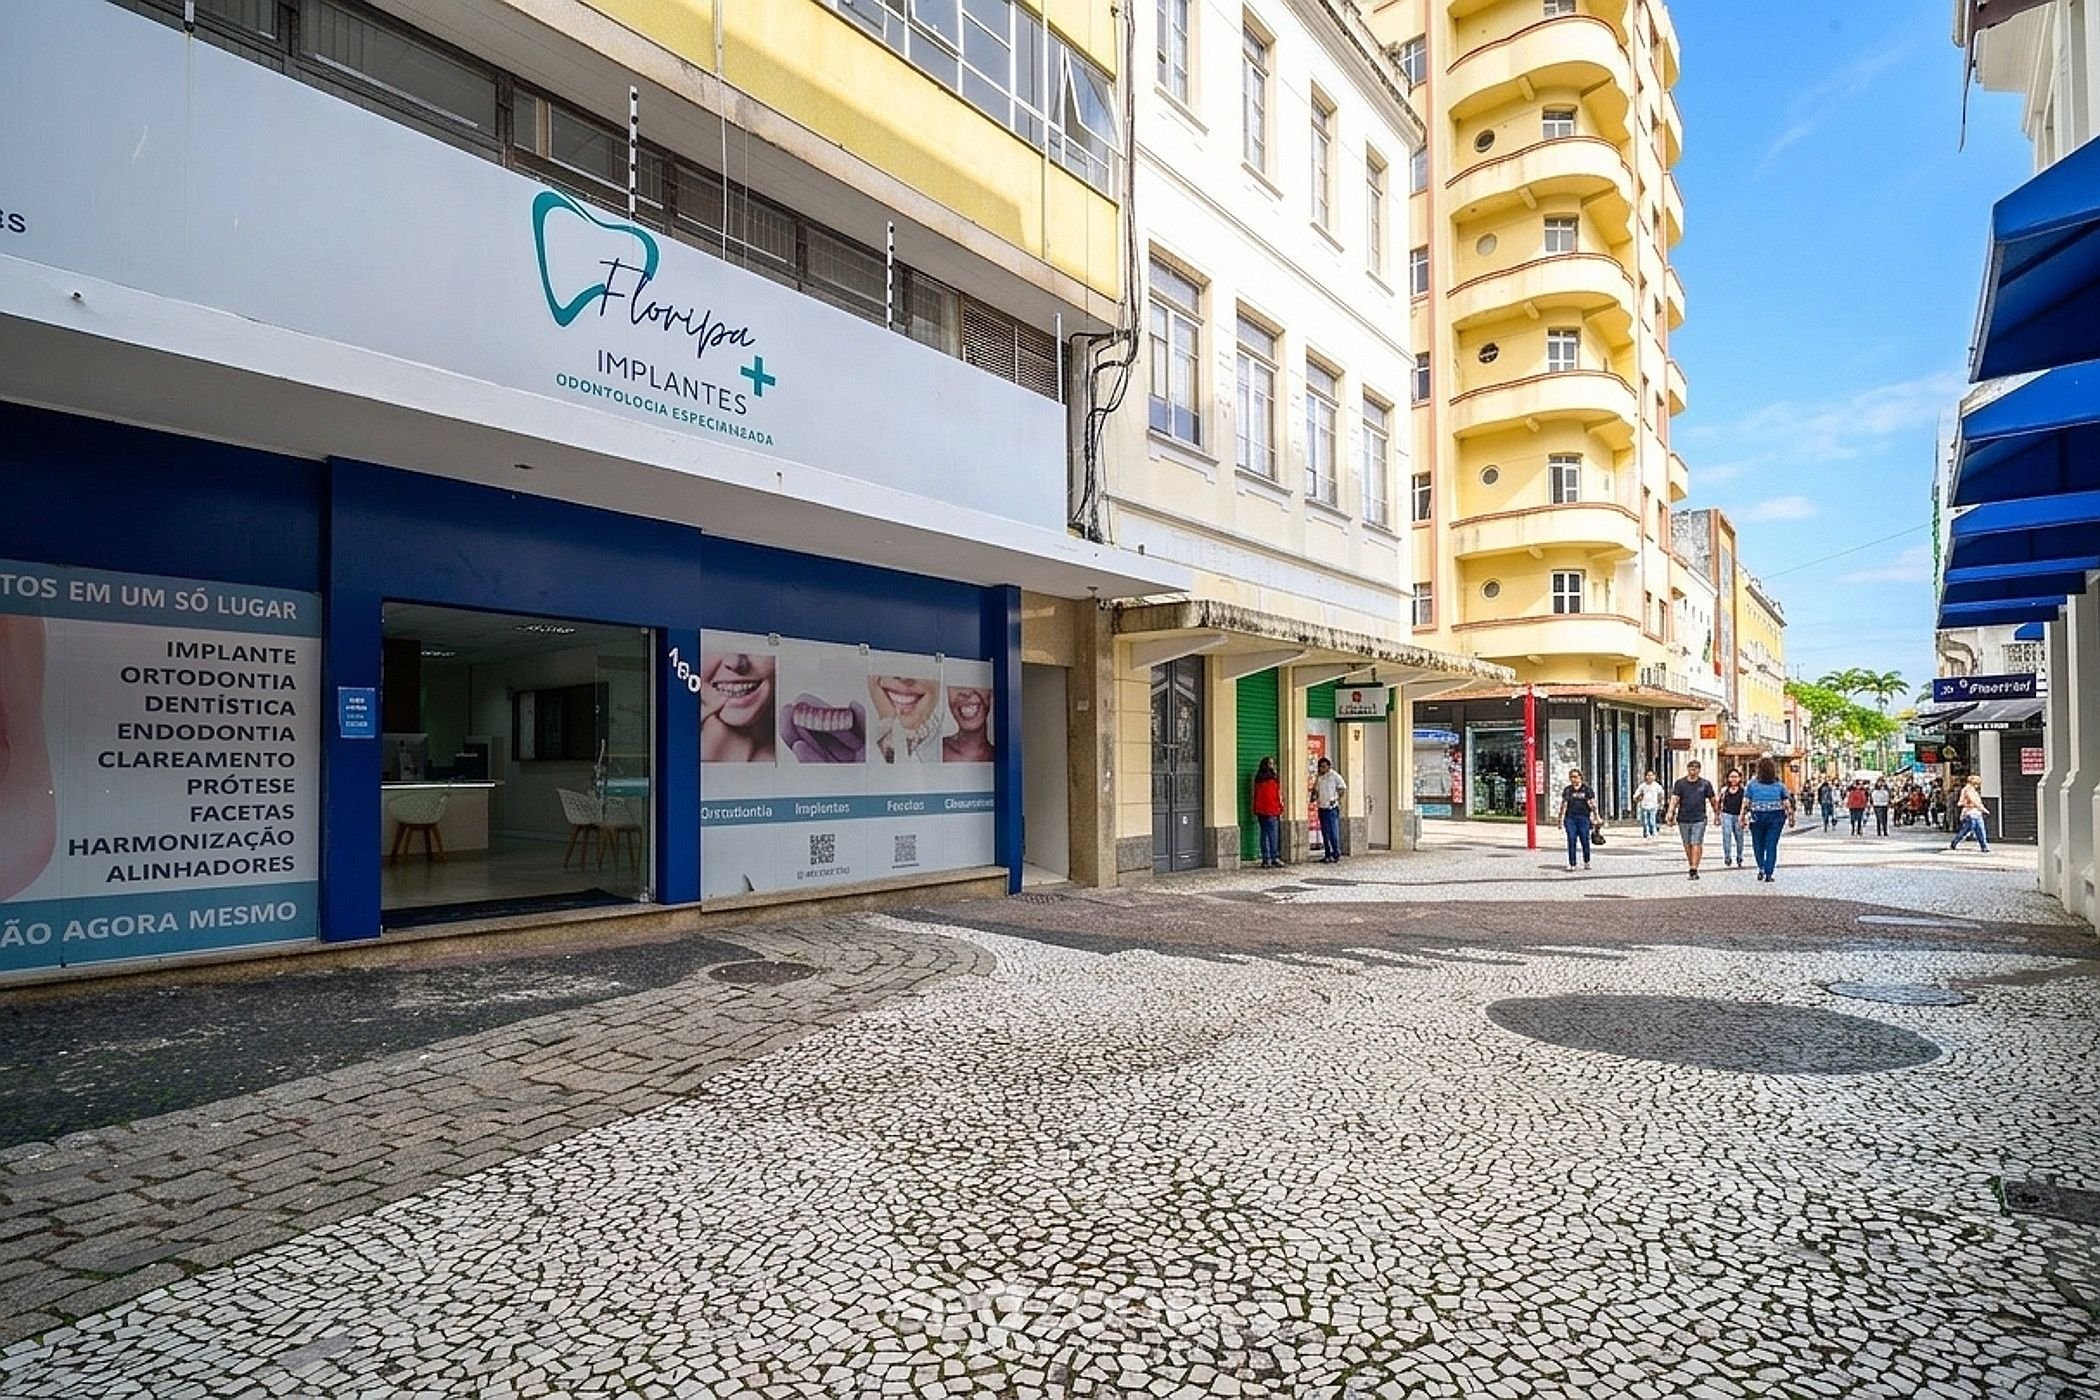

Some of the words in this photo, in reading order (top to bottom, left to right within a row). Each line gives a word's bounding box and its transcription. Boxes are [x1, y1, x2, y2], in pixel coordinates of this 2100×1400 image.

[600, 257, 756, 359] Floripa
[556, 373, 668, 416] ODONTOLOGIA
[597, 349, 748, 416] IMPLANTES
[69, 581, 111, 604] EM
[121, 586, 165, 608] UM
[175, 588, 209, 613] SÓ
[217, 595, 297, 619] LUGAR
[166, 641, 297, 665] IMPLANTE
[120, 667, 297, 690] ORTODONTIA
[145, 694, 297, 716] DENTÍSTICA
[117, 723, 297, 742] ENDODONTIA
[97, 751, 296, 769] CLAREAMENTO
[187, 775, 296, 795] PRÓTESE
[190, 804, 295, 822] FACETAS
[68, 827, 295, 856] HARMONIZAÇÃO
[106, 856, 295, 883] ALINHADORES
[62, 913, 180, 942] AGORA
[189, 902, 297, 929] MESMO
